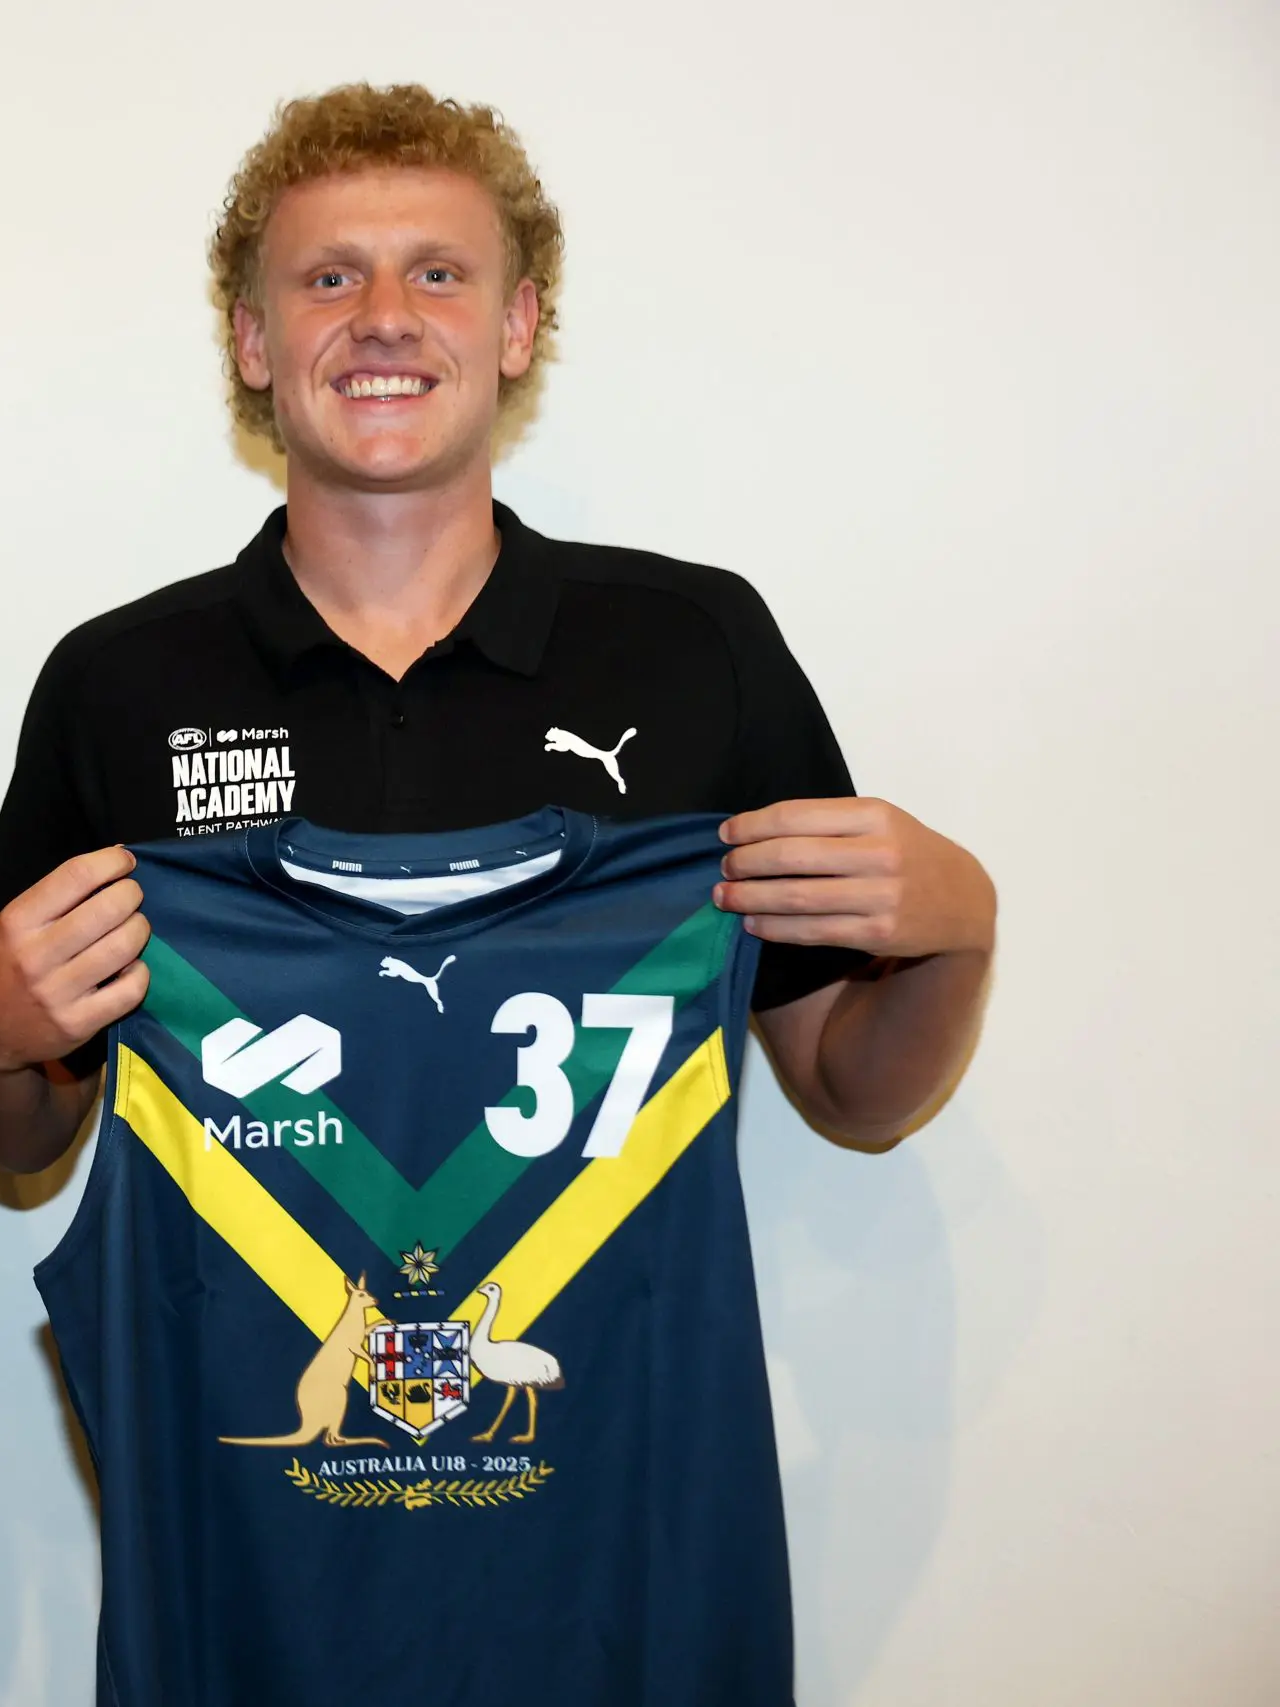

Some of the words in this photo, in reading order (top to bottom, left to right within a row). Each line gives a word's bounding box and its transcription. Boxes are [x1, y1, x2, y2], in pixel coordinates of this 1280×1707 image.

[173, 733, 204, 746] AFL
[241, 727, 289, 741] Marsh
[172, 746, 296, 788] NATIONAL
[175, 780, 297, 823] ACADEMY
[332, 860, 363, 873] PUMA
[449, 859, 481, 872] PUMA
[484, 992, 675, 1159] 37
[203, 1111, 344, 1153] Marsh
[318, 1456, 427, 1476] AUSTRALIA
[432, 1455, 467, 1472] U18
[482, 1455, 532, 1472] 2025
